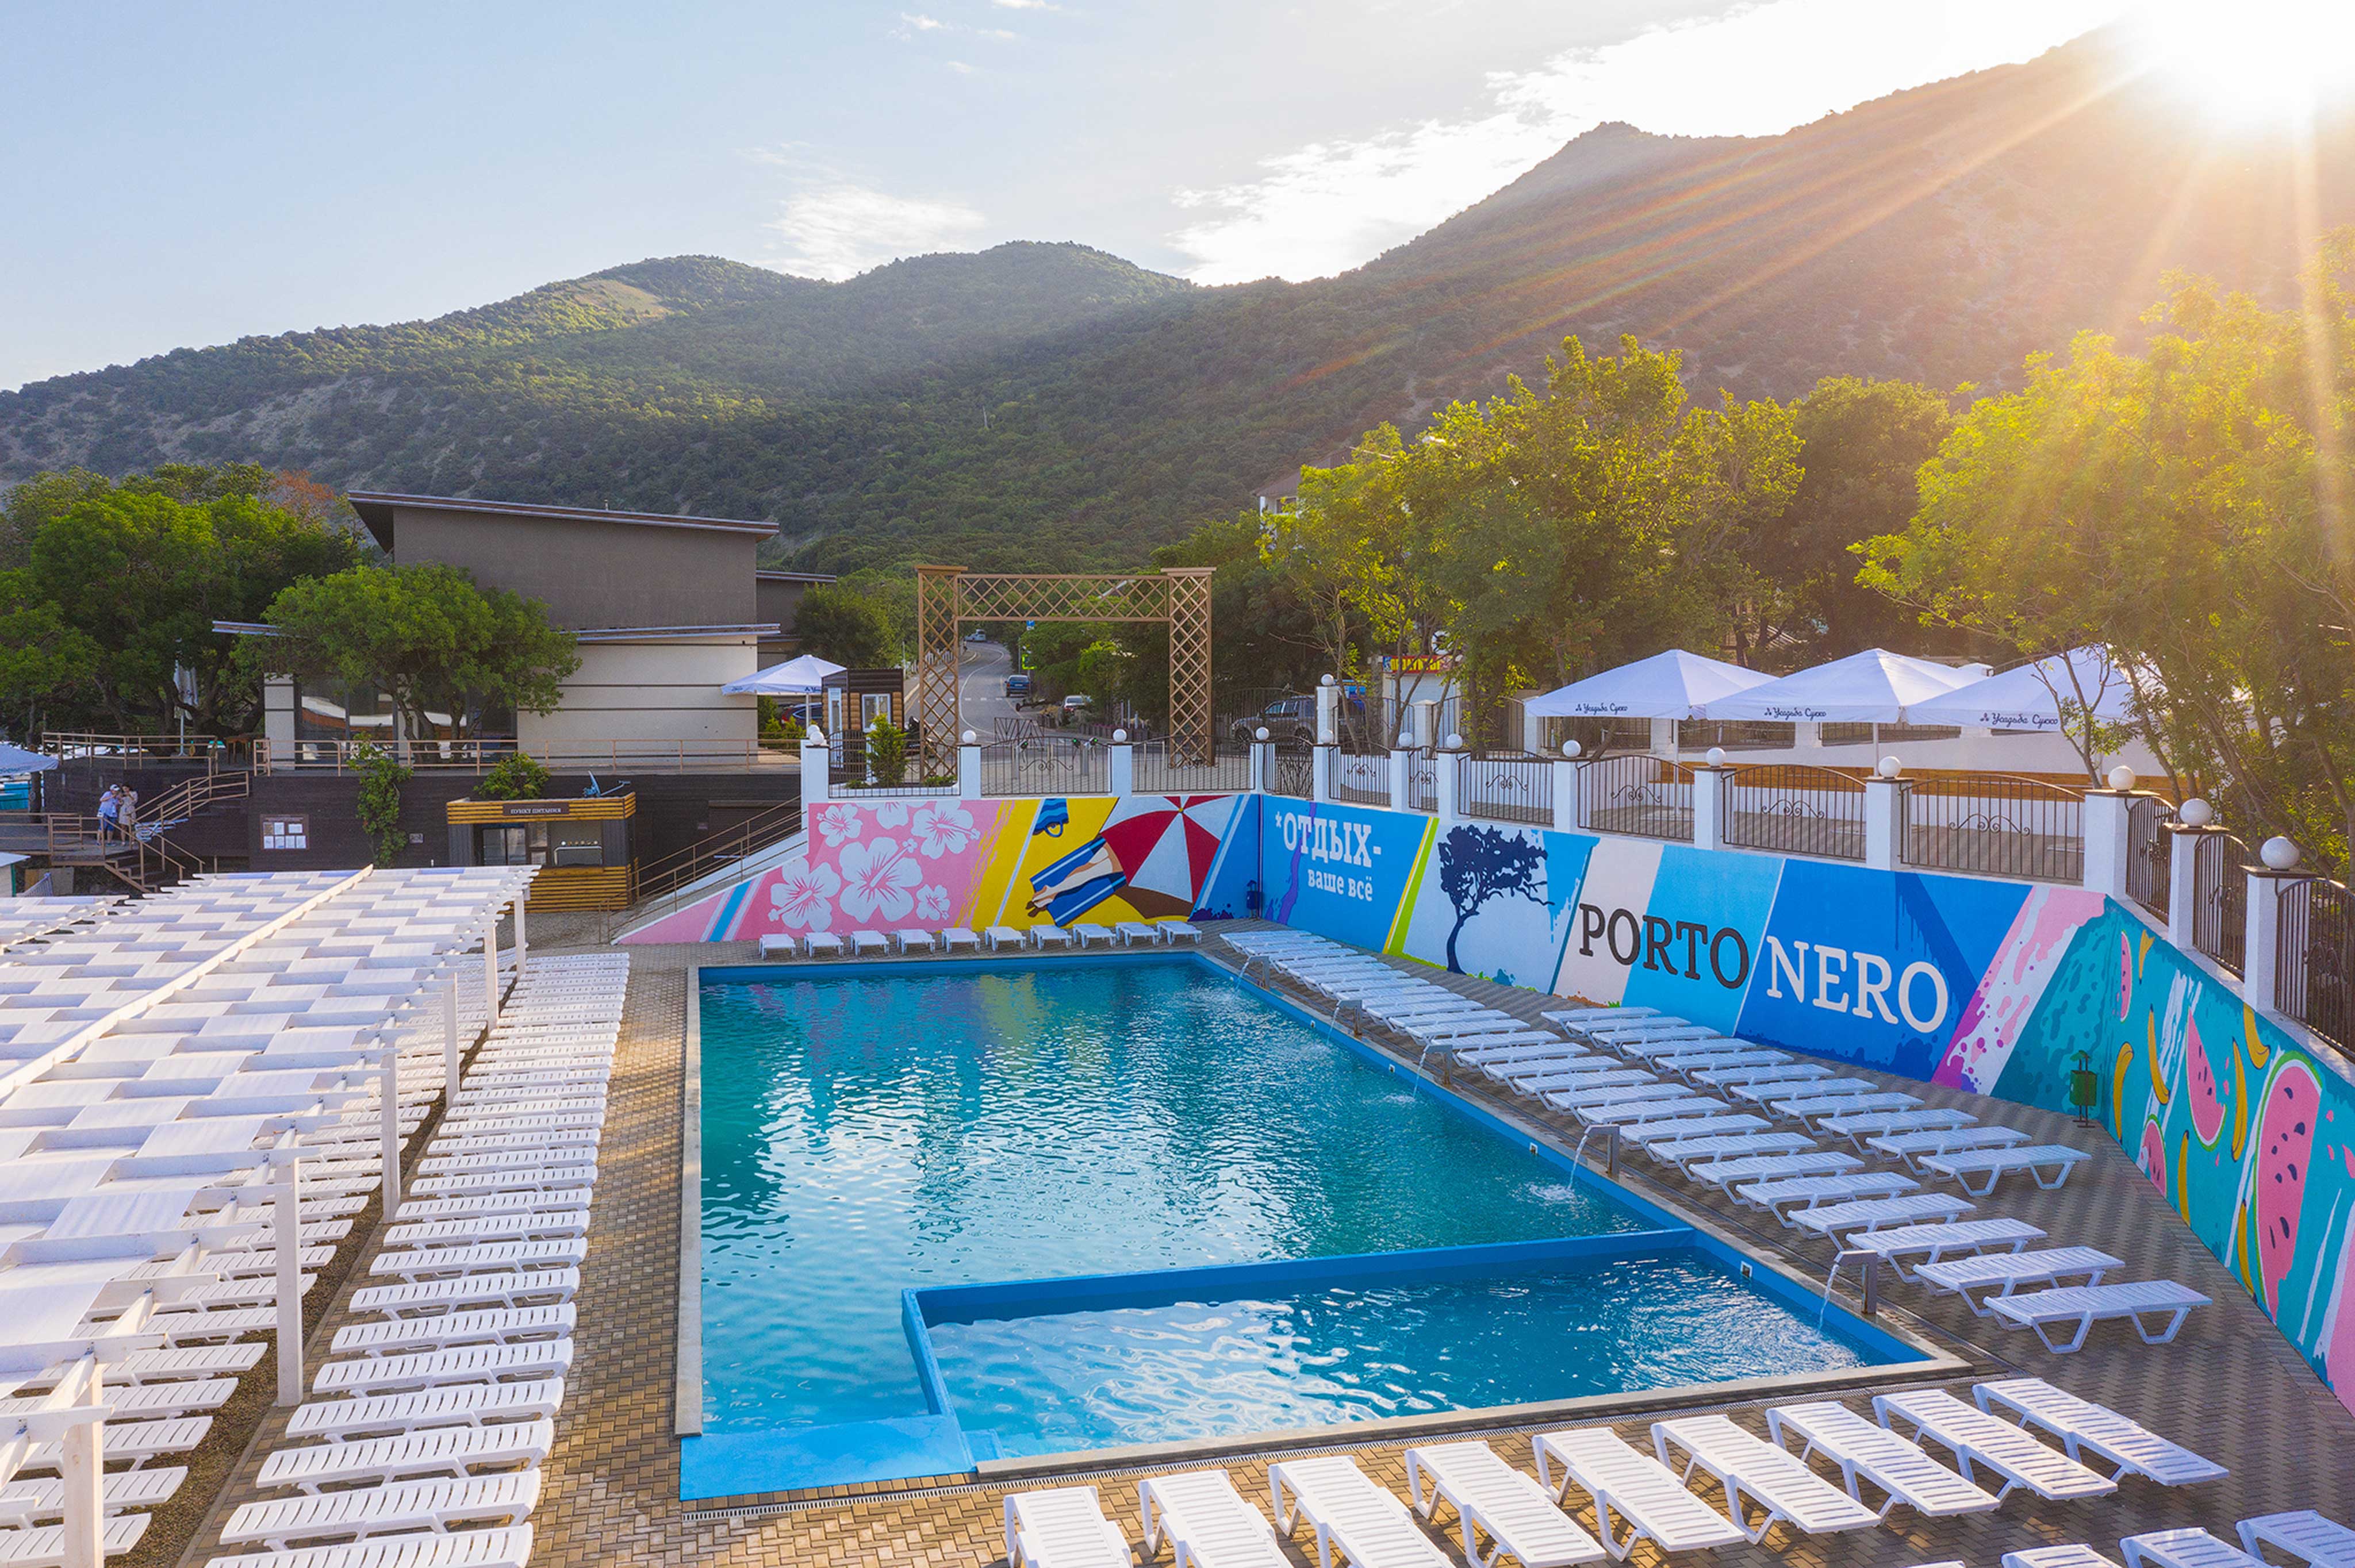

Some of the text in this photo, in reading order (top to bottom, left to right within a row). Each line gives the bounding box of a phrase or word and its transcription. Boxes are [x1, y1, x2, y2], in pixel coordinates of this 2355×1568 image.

[1992, 713, 2028, 727] Усадьба
[1308, 869, 1373, 902] ваше всё
[1579, 903, 1948, 1033] PORTO NERO
